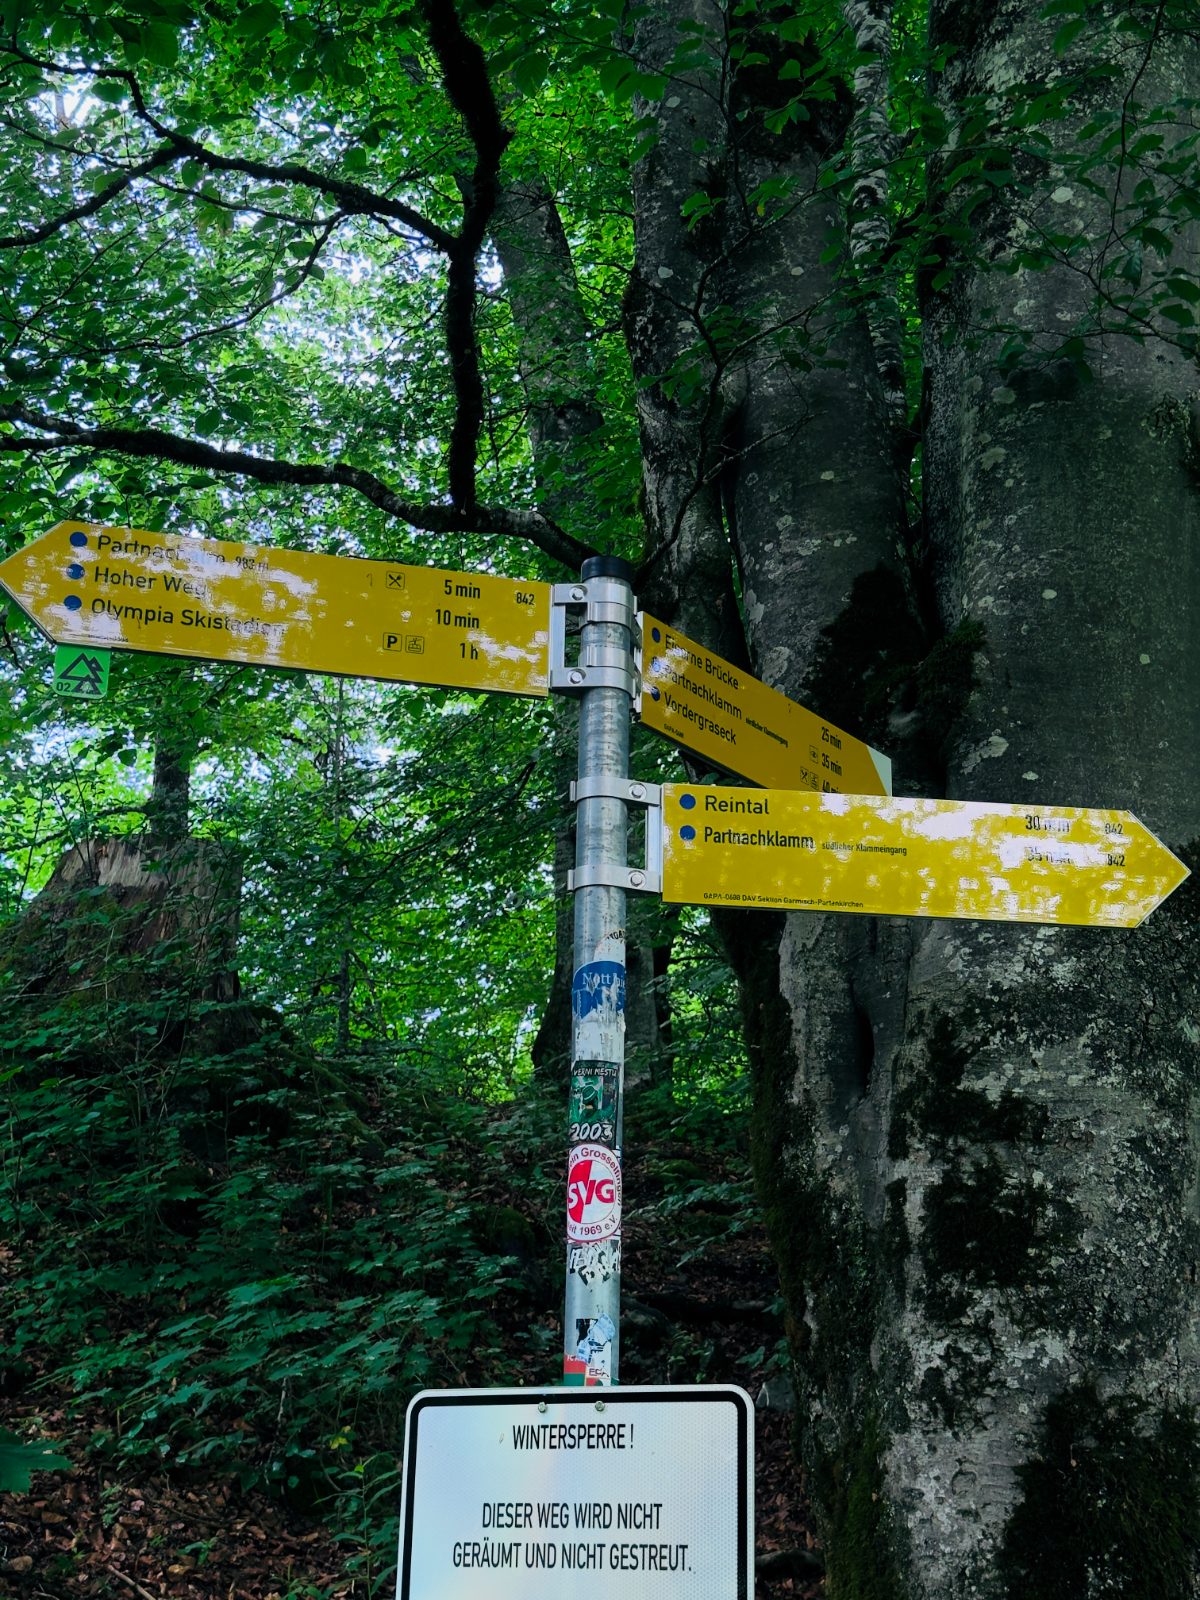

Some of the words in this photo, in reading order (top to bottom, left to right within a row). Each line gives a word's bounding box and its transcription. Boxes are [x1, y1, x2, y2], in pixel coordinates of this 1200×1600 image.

[94, 565, 158, 590] Hoher
[444, 579, 453, 596] 5
[455, 582, 481, 600] min
[515, 591, 536, 606] 842
[91, 598, 174, 627] Olympia
[434, 608, 452, 626] 10
[454, 611, 480, 629] min
[386, 635, 398, 649] P
[459, 642, 466, 659] 1
[470, 643, 479, 661] h
[705, 657, 739, 690] Brücke
[56, 681, 71, 693] 02
[664, 692, 737, 745] Vordergraseck
[821, 726, 830, 743] 25
[830, 734, 842, 751] min
[821, 752, 830, 770] 35
[830, 761, 843, 777] min
[704, 795, 770, 815] Reintal
[1024, 813, 1041, 831] 30
[704, 826, 815, 849] Partnachklamm
[855, 843, 908, 857] Klammeingang
[1106, 853, 1126, 867] 842
[742, 894, 757, 902] DAV
[783, 896, 864, 908] Garmisch-Partenkirchen
[567, 1178, 615, 1210] SVG
[580, 1224, 603, 1236] 1969
[481, 1502, 533, 1528] DIESER
[536, 1502, 570, 1529] WEG
[573, 1503, 613, 1529] WIRD
[616, 1503, 663, 1530] NICHT
[452, 1537, 522, 1568] GERÄUMT
[525, 1542, 557, 1569] UND
[560, 1543, 606, 1570] NICHT
[609, 1544, 692, 1572] GESTREUT.
